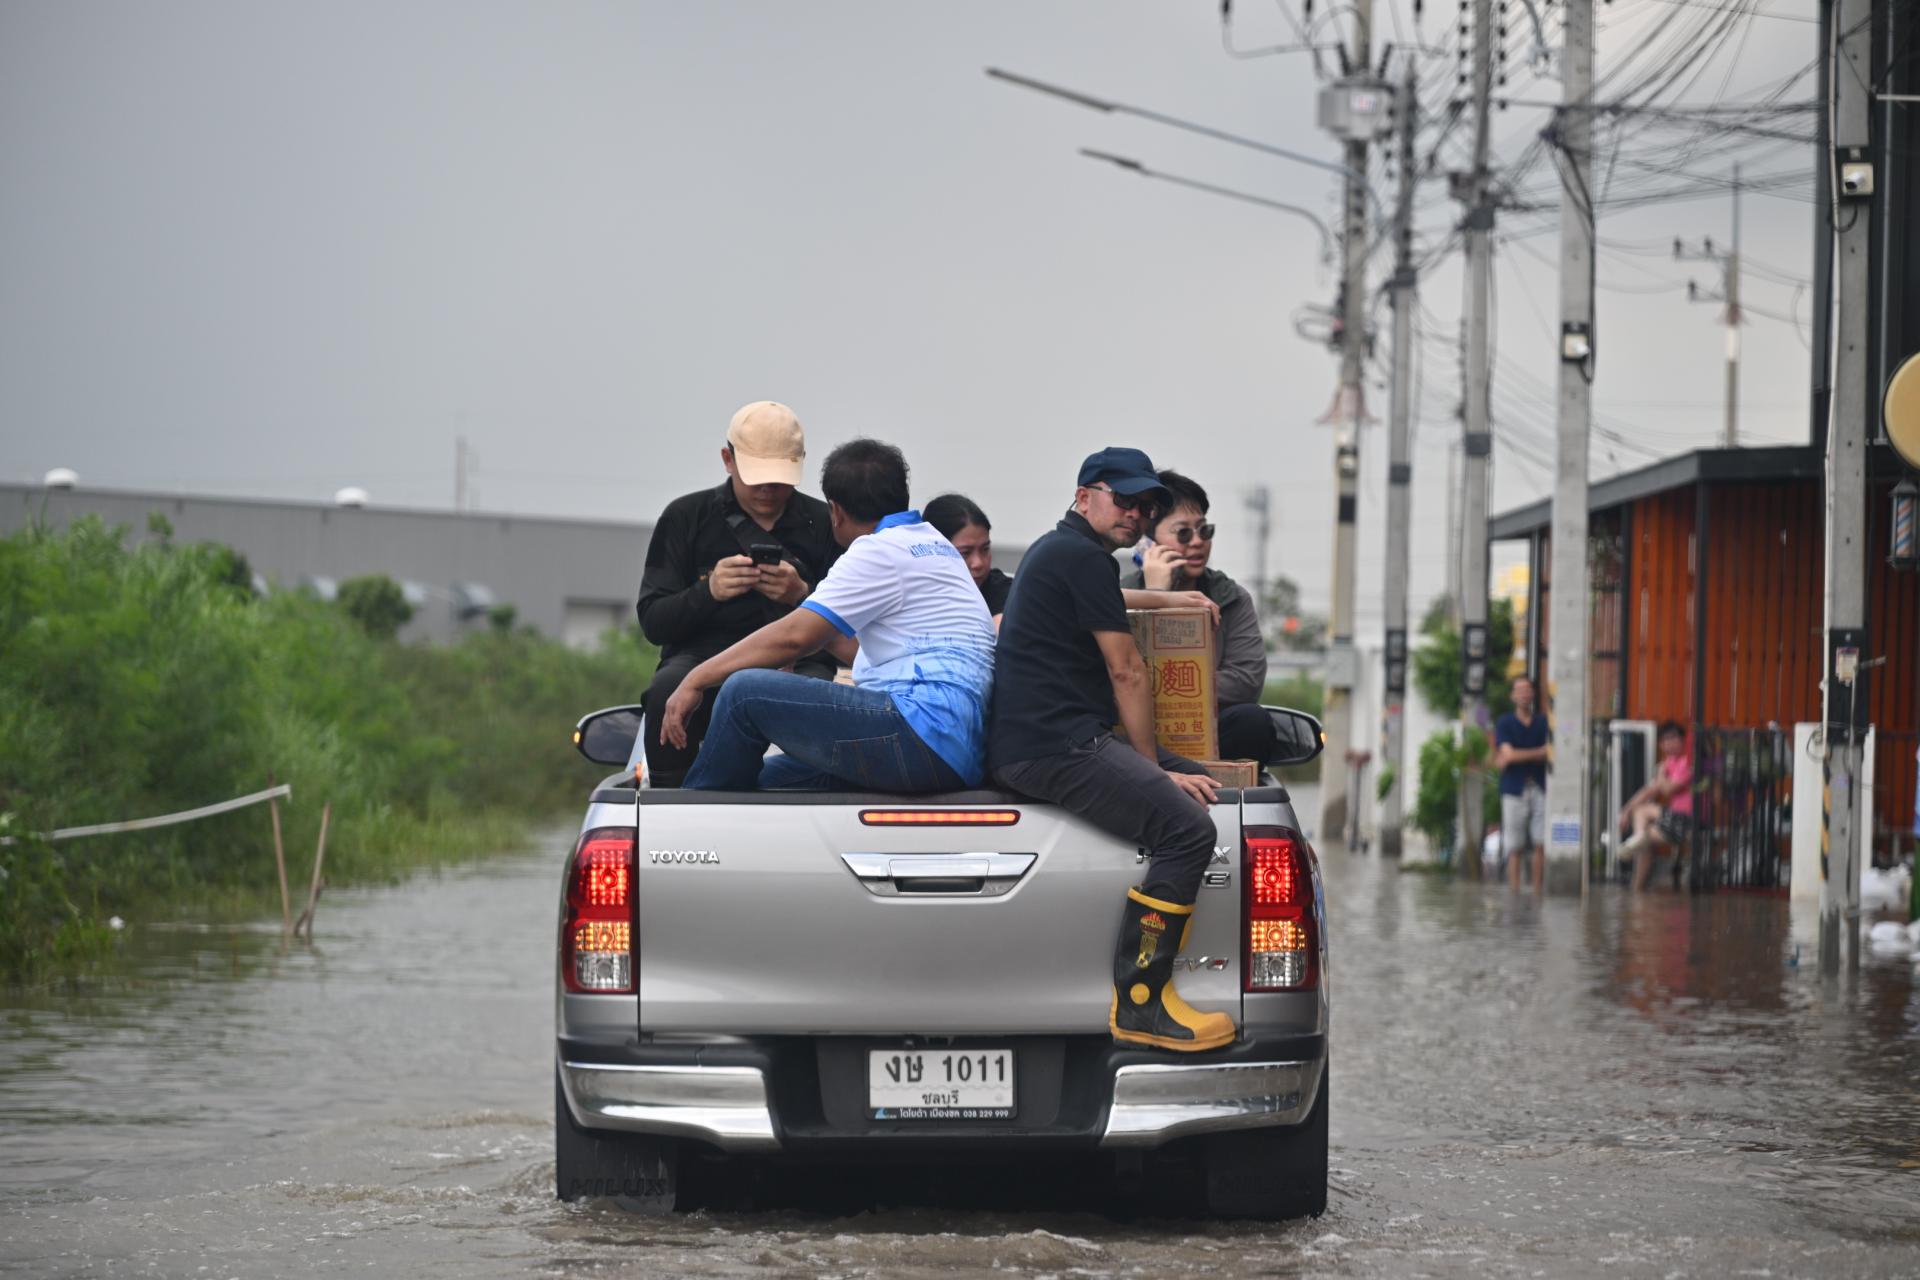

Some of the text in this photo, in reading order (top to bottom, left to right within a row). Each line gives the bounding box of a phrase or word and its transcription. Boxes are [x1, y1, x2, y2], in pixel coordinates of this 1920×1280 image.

[1173, 721, 1186, 732] 30
[649, 850, 720, 864] TOYOTA
[942, 1055, 1004, 1082] 1011
[922, 1090, 959, 1107] ชลบุรี
[569, 1178, 667, 1197] HILUX
